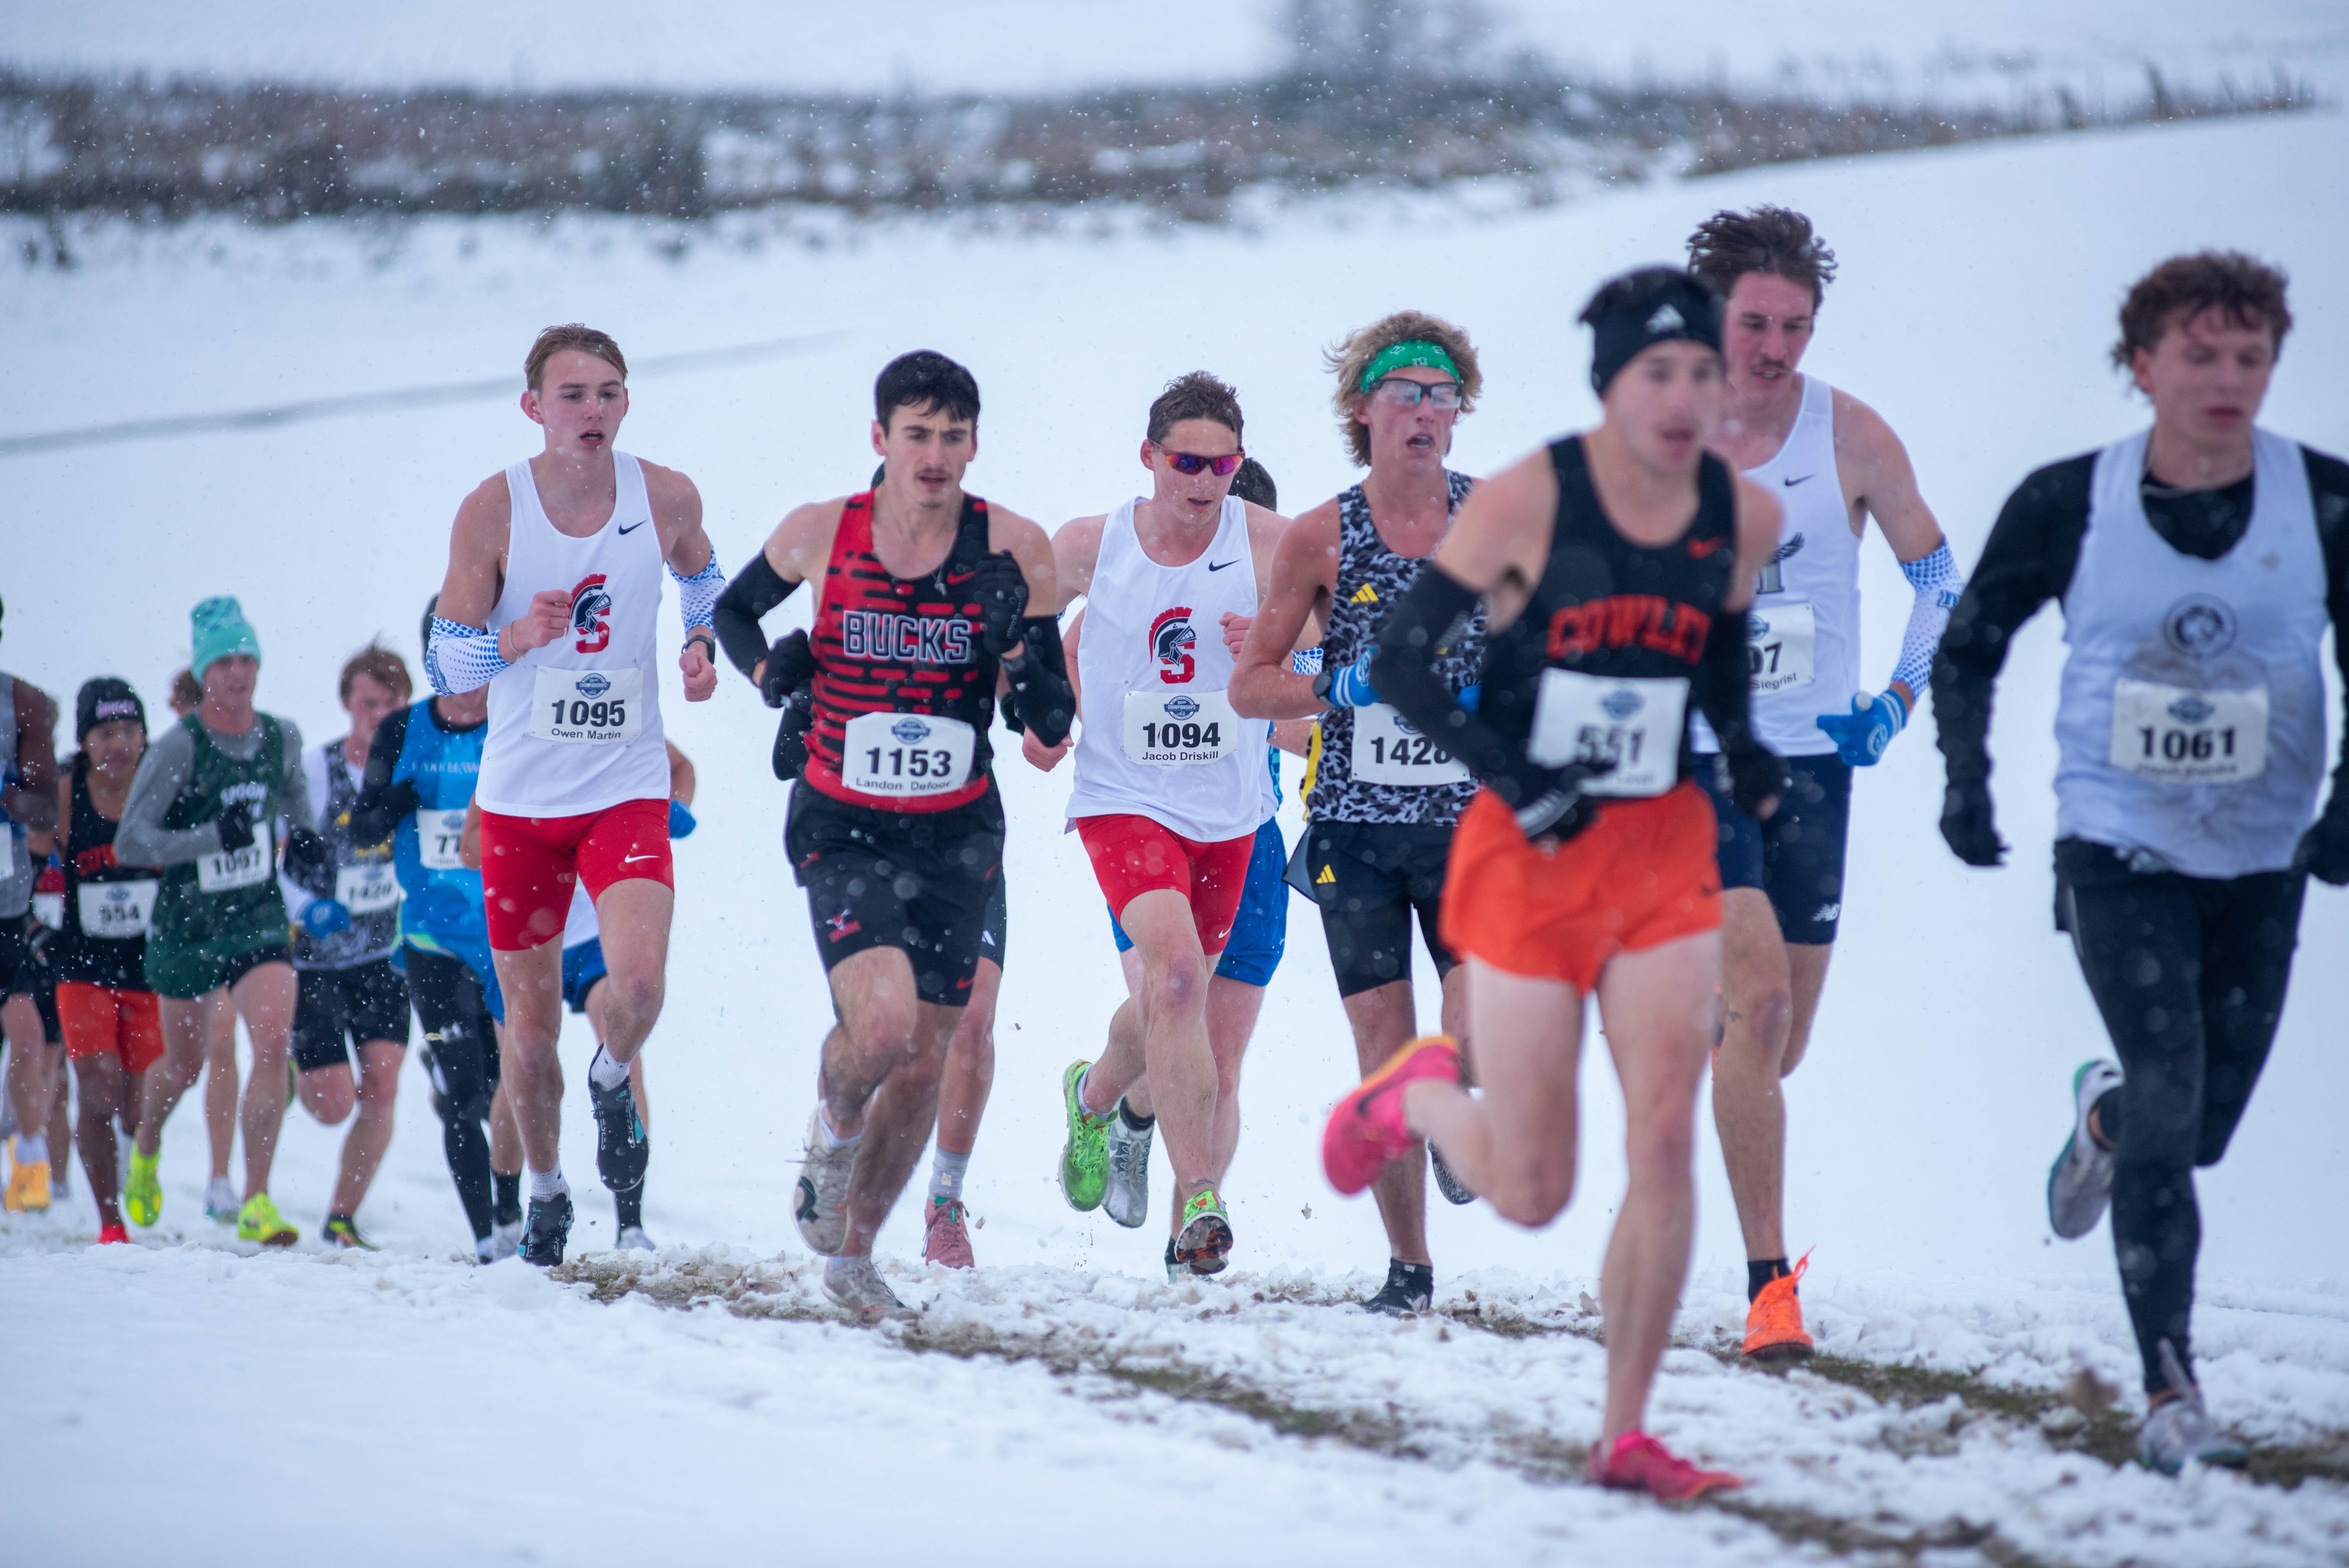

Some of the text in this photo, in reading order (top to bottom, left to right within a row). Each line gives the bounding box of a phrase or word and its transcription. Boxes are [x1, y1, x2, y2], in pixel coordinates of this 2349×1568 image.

[843, 609, 973, 665] BUCKS
[551, 699, 626, 728] 1095
[551, 728, 621, 740] Owen Martin
[1142, 722, 1221, 749] 1094
[1577, 724, 1644, 766] 551
[2138, 725, 2236, 763] 1061
[865, 746, 952, 777] 1153
[1142, 751, 1219, 761] Jacob Driskill
[856, 777, 903, 791] Landon
[434, 834, 461, 855] 77
[213, 850, 262, 876] 1097
